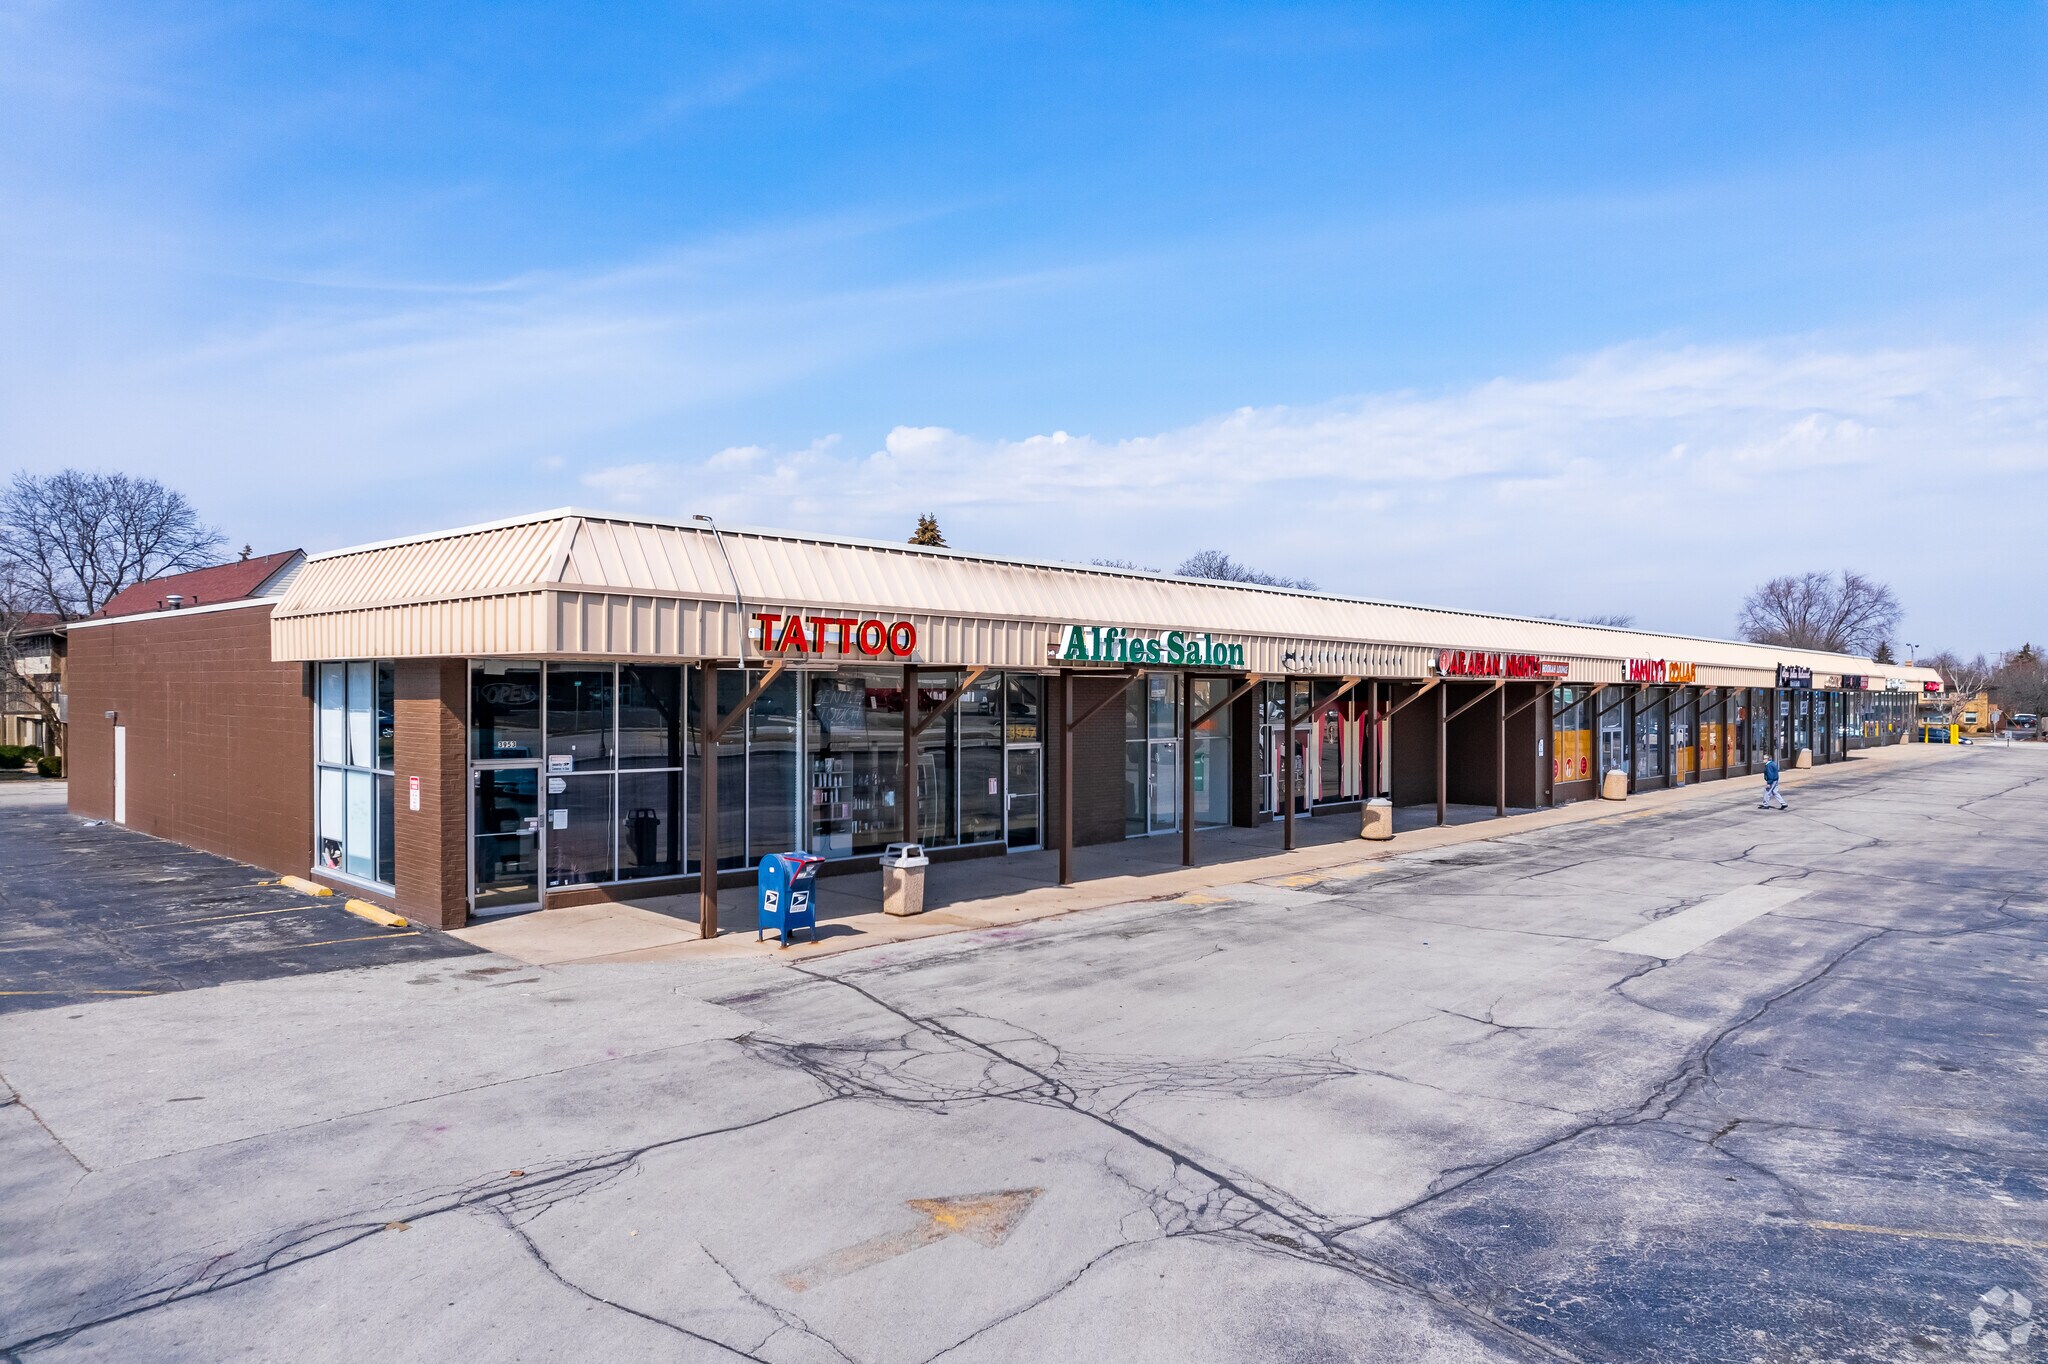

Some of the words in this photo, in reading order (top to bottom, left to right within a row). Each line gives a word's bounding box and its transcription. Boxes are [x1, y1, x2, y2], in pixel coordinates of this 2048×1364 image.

[753, 613, 917, 657] TATTOO
[1061, 625, 1161, 664] Alfies
[1166, 630, 1245, 666] Salon
[1449, 649, 1501, 677] ARABIAN
[1505, 653, 1541, 679] NIGHTS
[1629, 658, 1660, 682] FAMILY
[1668, 661, 1696, 683] DOLLAR
[487, 685, 534, 704] OPEN
[497, 740, 517, 749] 3953
